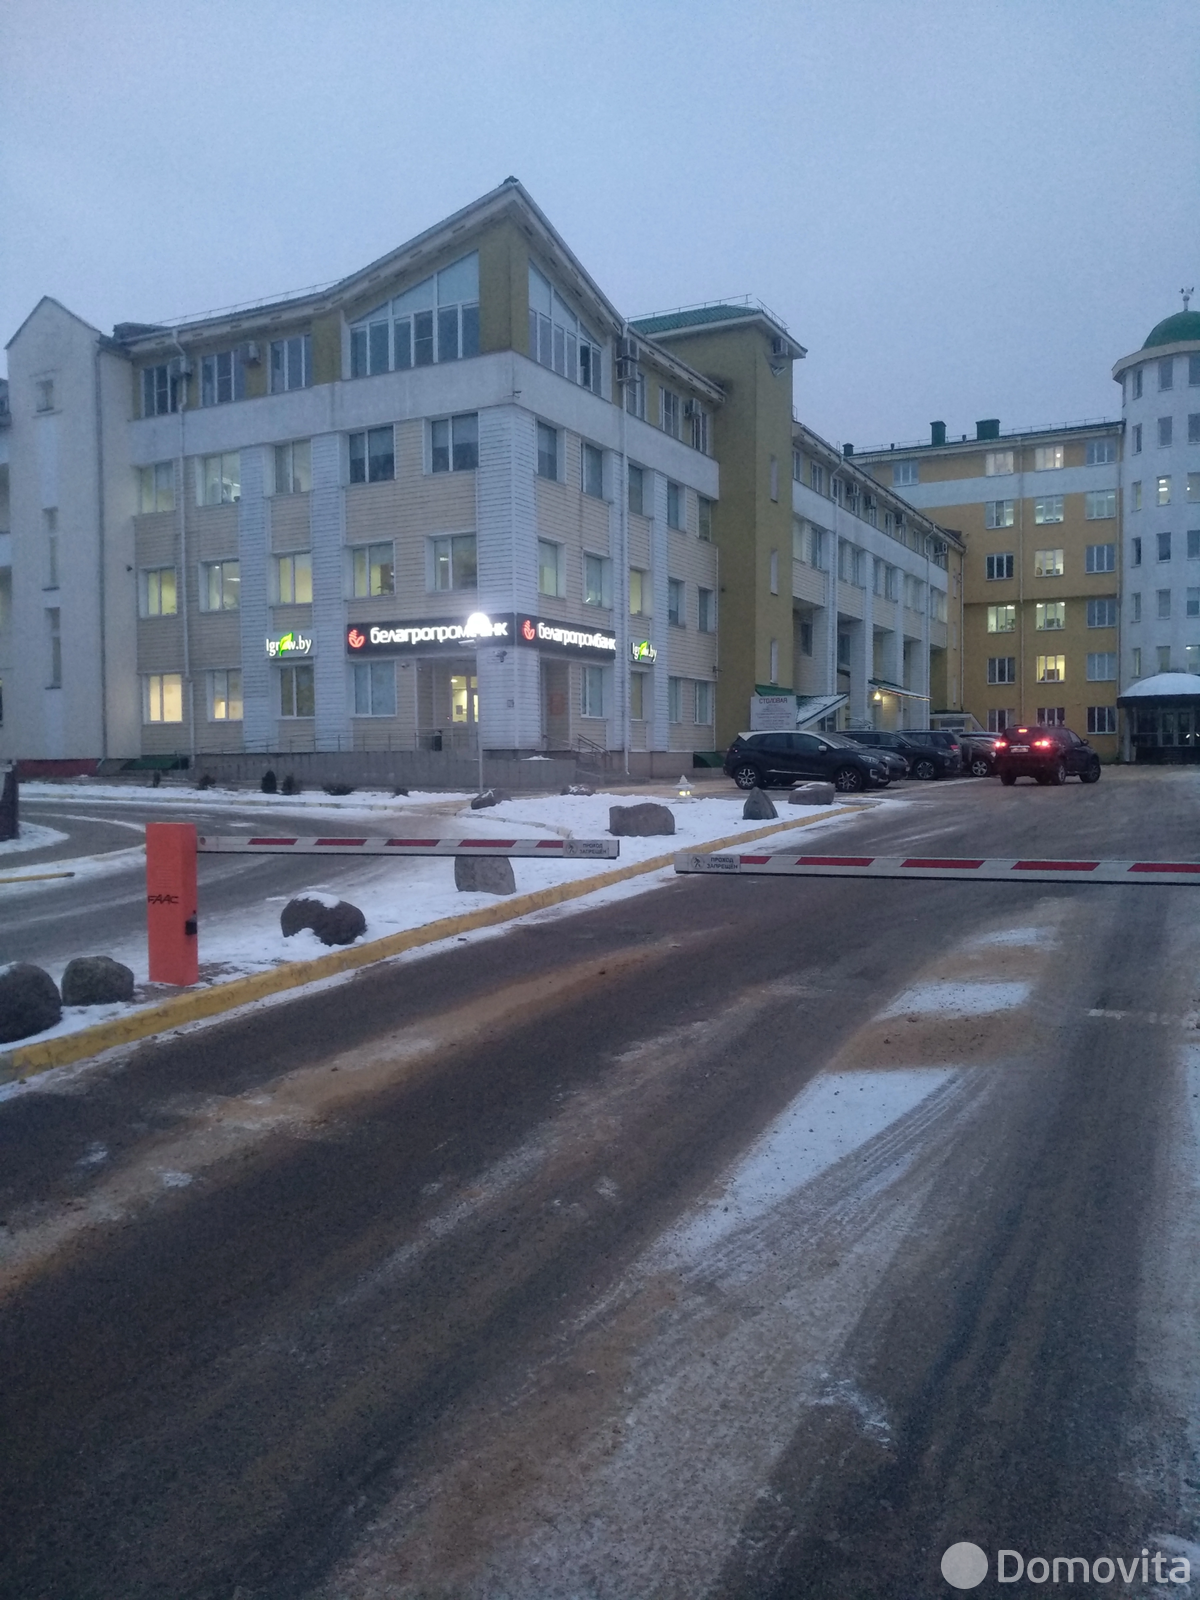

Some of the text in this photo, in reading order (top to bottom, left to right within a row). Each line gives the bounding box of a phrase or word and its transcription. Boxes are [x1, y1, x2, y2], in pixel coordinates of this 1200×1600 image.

[265, 632, 312, 657] Igrw.by
[370, 622, 508, 645] белагропромнк
[537, 622, 616, 650] белагропромбанк
[147, 894, 179, 905] FAAC
